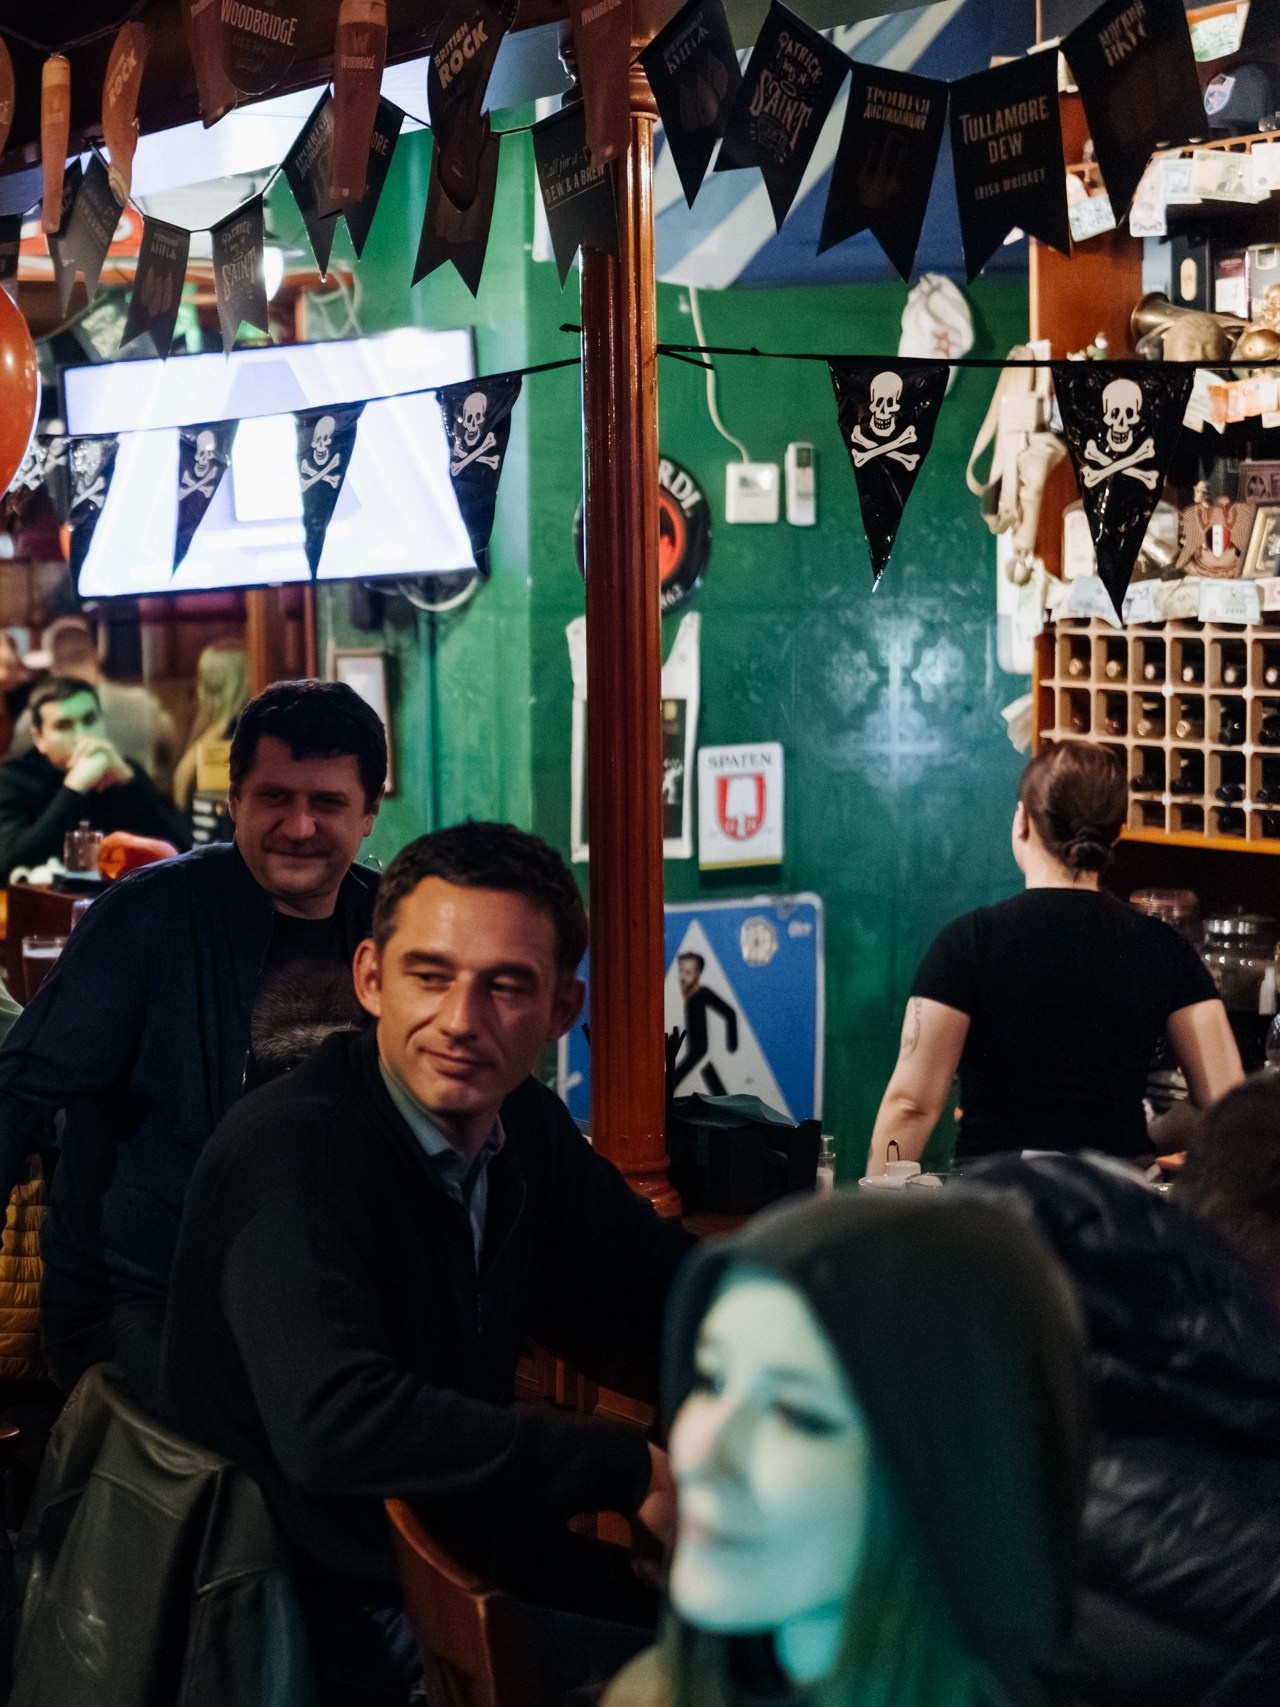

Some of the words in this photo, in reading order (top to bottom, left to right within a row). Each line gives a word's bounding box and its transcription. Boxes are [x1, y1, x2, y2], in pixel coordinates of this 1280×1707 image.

[220, 0, 298, 47] WOODBRIDGE
[433, 22, 470, 68] BRITISH
[436, 20, 489, 91] ROCK
[776, 31, 824, 84] PATRICK
[748, 68, 814, 152] SAINT
[959, 94, 1050, 145] TULLAMORE
[987, 131, 1025, 164] DEW
[708, 751, 773, 768] SPATEN
